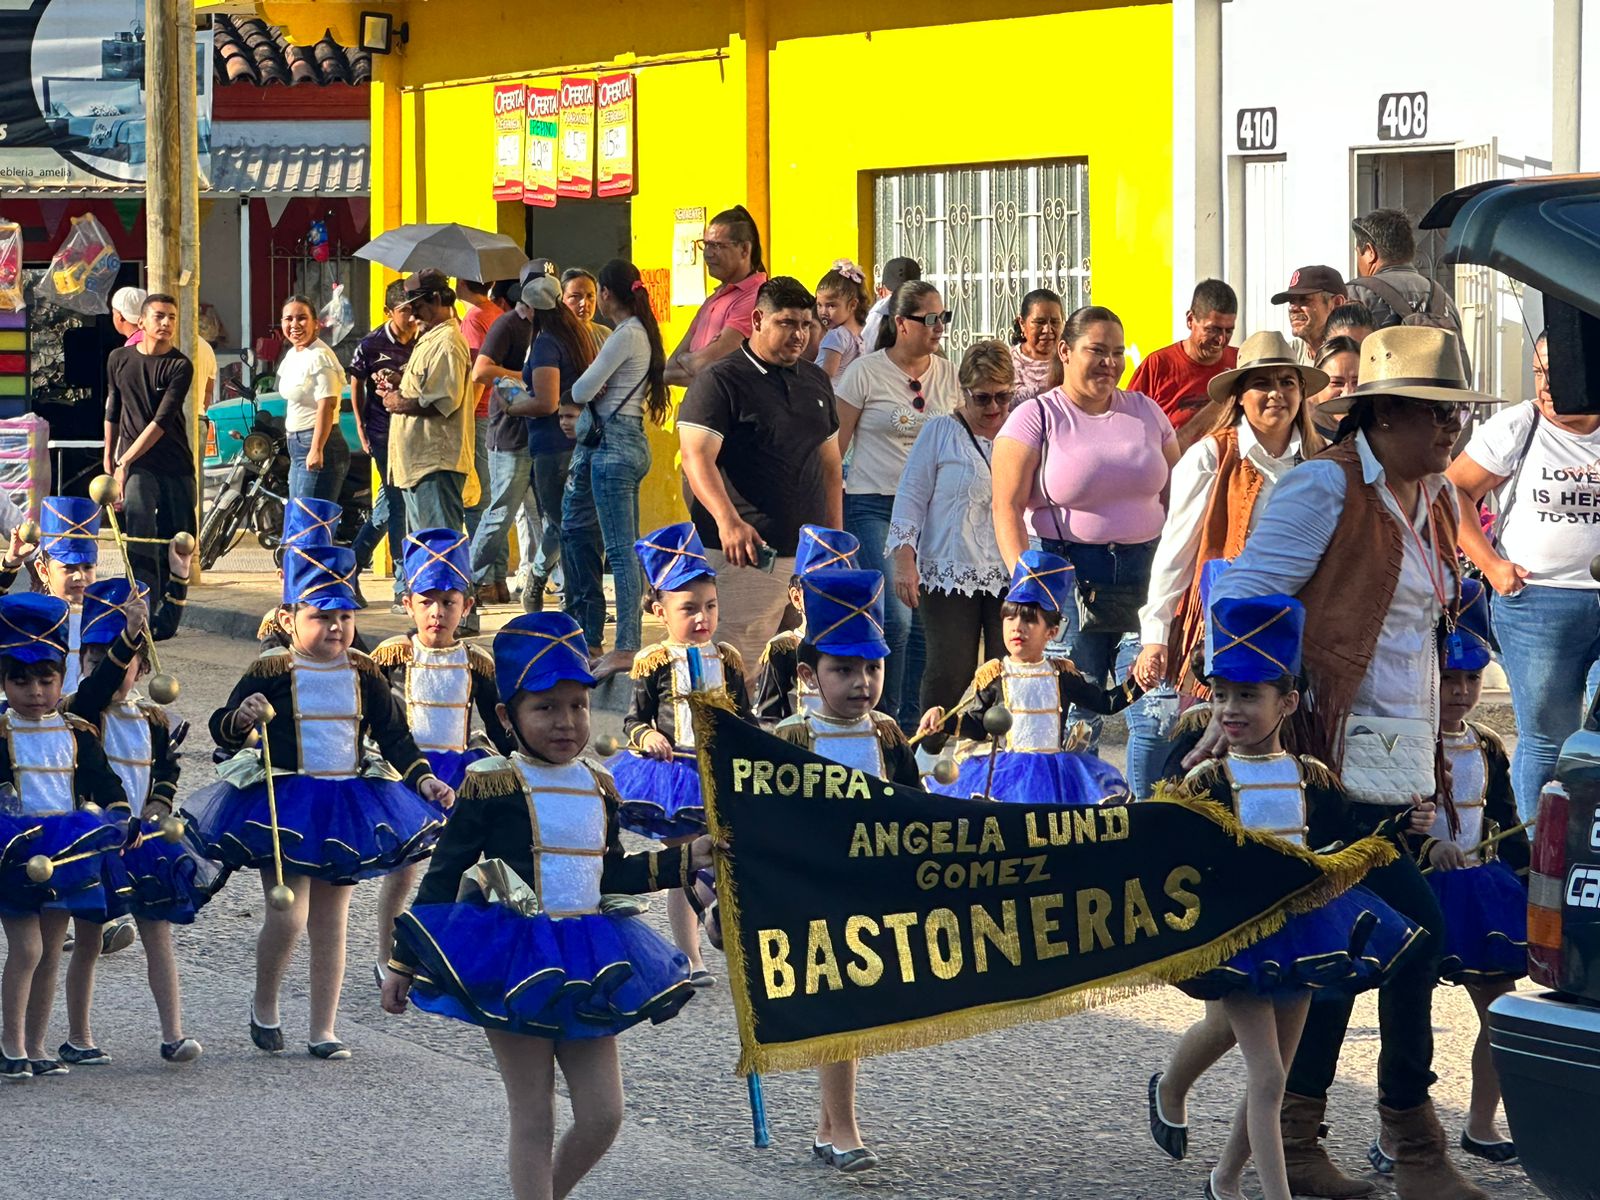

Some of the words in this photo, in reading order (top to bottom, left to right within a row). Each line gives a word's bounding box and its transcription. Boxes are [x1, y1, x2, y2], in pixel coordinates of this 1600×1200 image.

[1239, 111, 1274, 147] 410
[1382, 94, 1426, 137] 408
[1542, 467, 1600, 484] LOVE
[1532, 488, 1551, 504] IS
[1536, 510, 1565, 523] TO
[848, 817, 1006, 858] ANGELA
[1025, 805, 1129, 848] LUND
[916, 855, 1052, 890] GOMEZ
[757, 864, 1202, 1000] BASTONERAS
